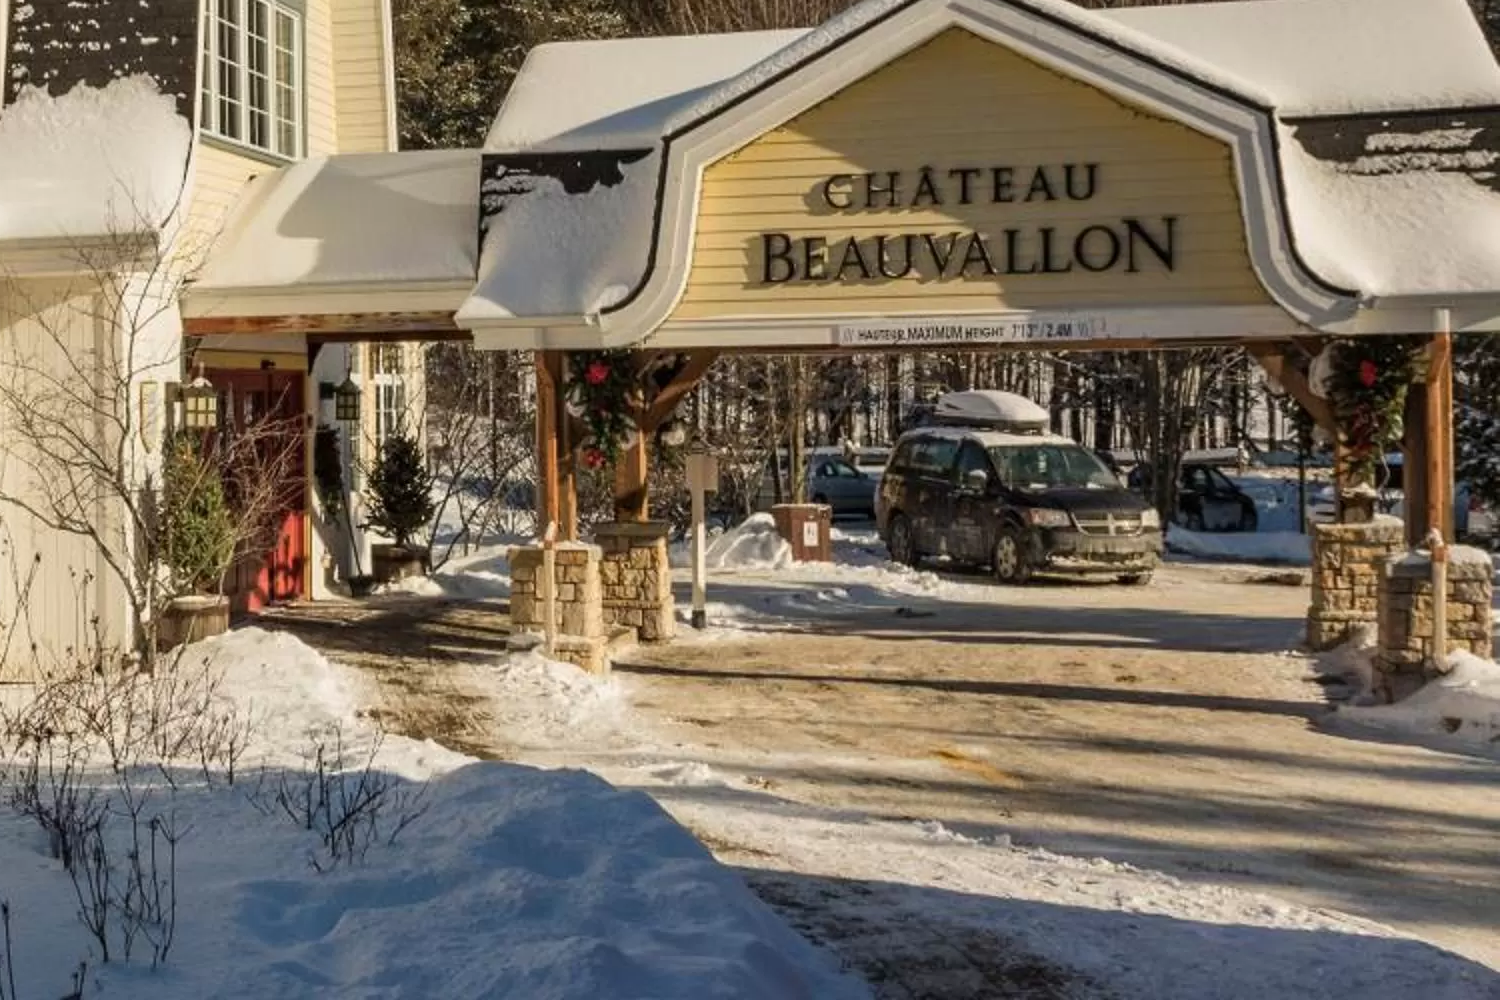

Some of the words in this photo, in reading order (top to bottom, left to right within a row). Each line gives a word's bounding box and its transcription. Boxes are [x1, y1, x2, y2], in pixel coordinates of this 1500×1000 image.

[823, 163, 1098, 209] CHÂTEAU
[761, 216, 1178, 284] BEAUVALLON
[858, 327, 905, 341] HAUTEUR
[907, 325, 963, 341] MAXIMUM
[965, 326, 1004, 340] HEIGHT
